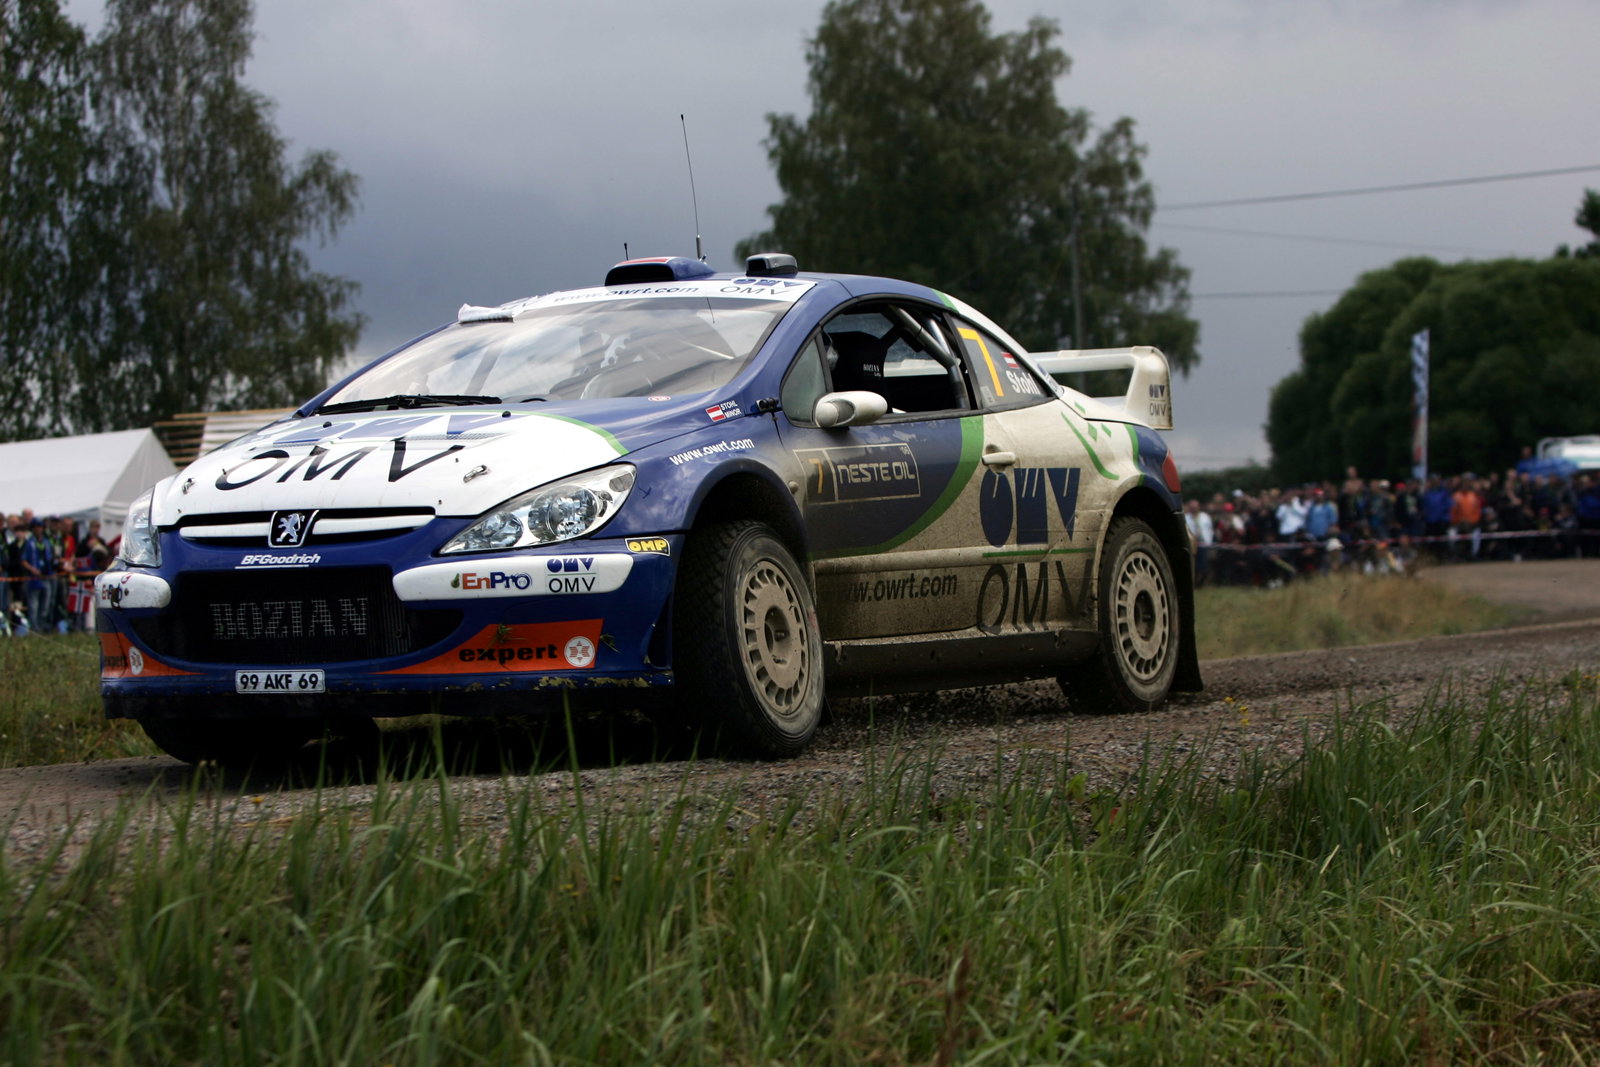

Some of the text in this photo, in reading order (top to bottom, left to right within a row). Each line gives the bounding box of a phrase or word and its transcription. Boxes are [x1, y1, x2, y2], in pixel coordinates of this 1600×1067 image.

[720, 286, 790, 296] OMV
[957, 327, 1004, 397] 7
[1006, 370, 1040, 395] Stohl
[720, 401, 738, 411] STOHL
[724, 408, 741, 418] MINOR
[1150, 402, 1166, 416] OMV
[669, 439, 755, 465] www.owrt.com
[214, 437, 466, 491] OMV
[837, 462, 892, 484] NESTE
[892, 461, 916, 480] OIL
[628, 540, 667, 552] OMP
[240, 554, 321, 565] BFGoodrich
[462, 571, 532, 590] EnPro
[548, 577, 596, 593] OMV
[976, 559, 1094, 634] OMV
[210, 598, 368, 639] BOZIAN
[459, 644, 558, 665] expert
[240, 674, 318, 690] 99 AKF 69
